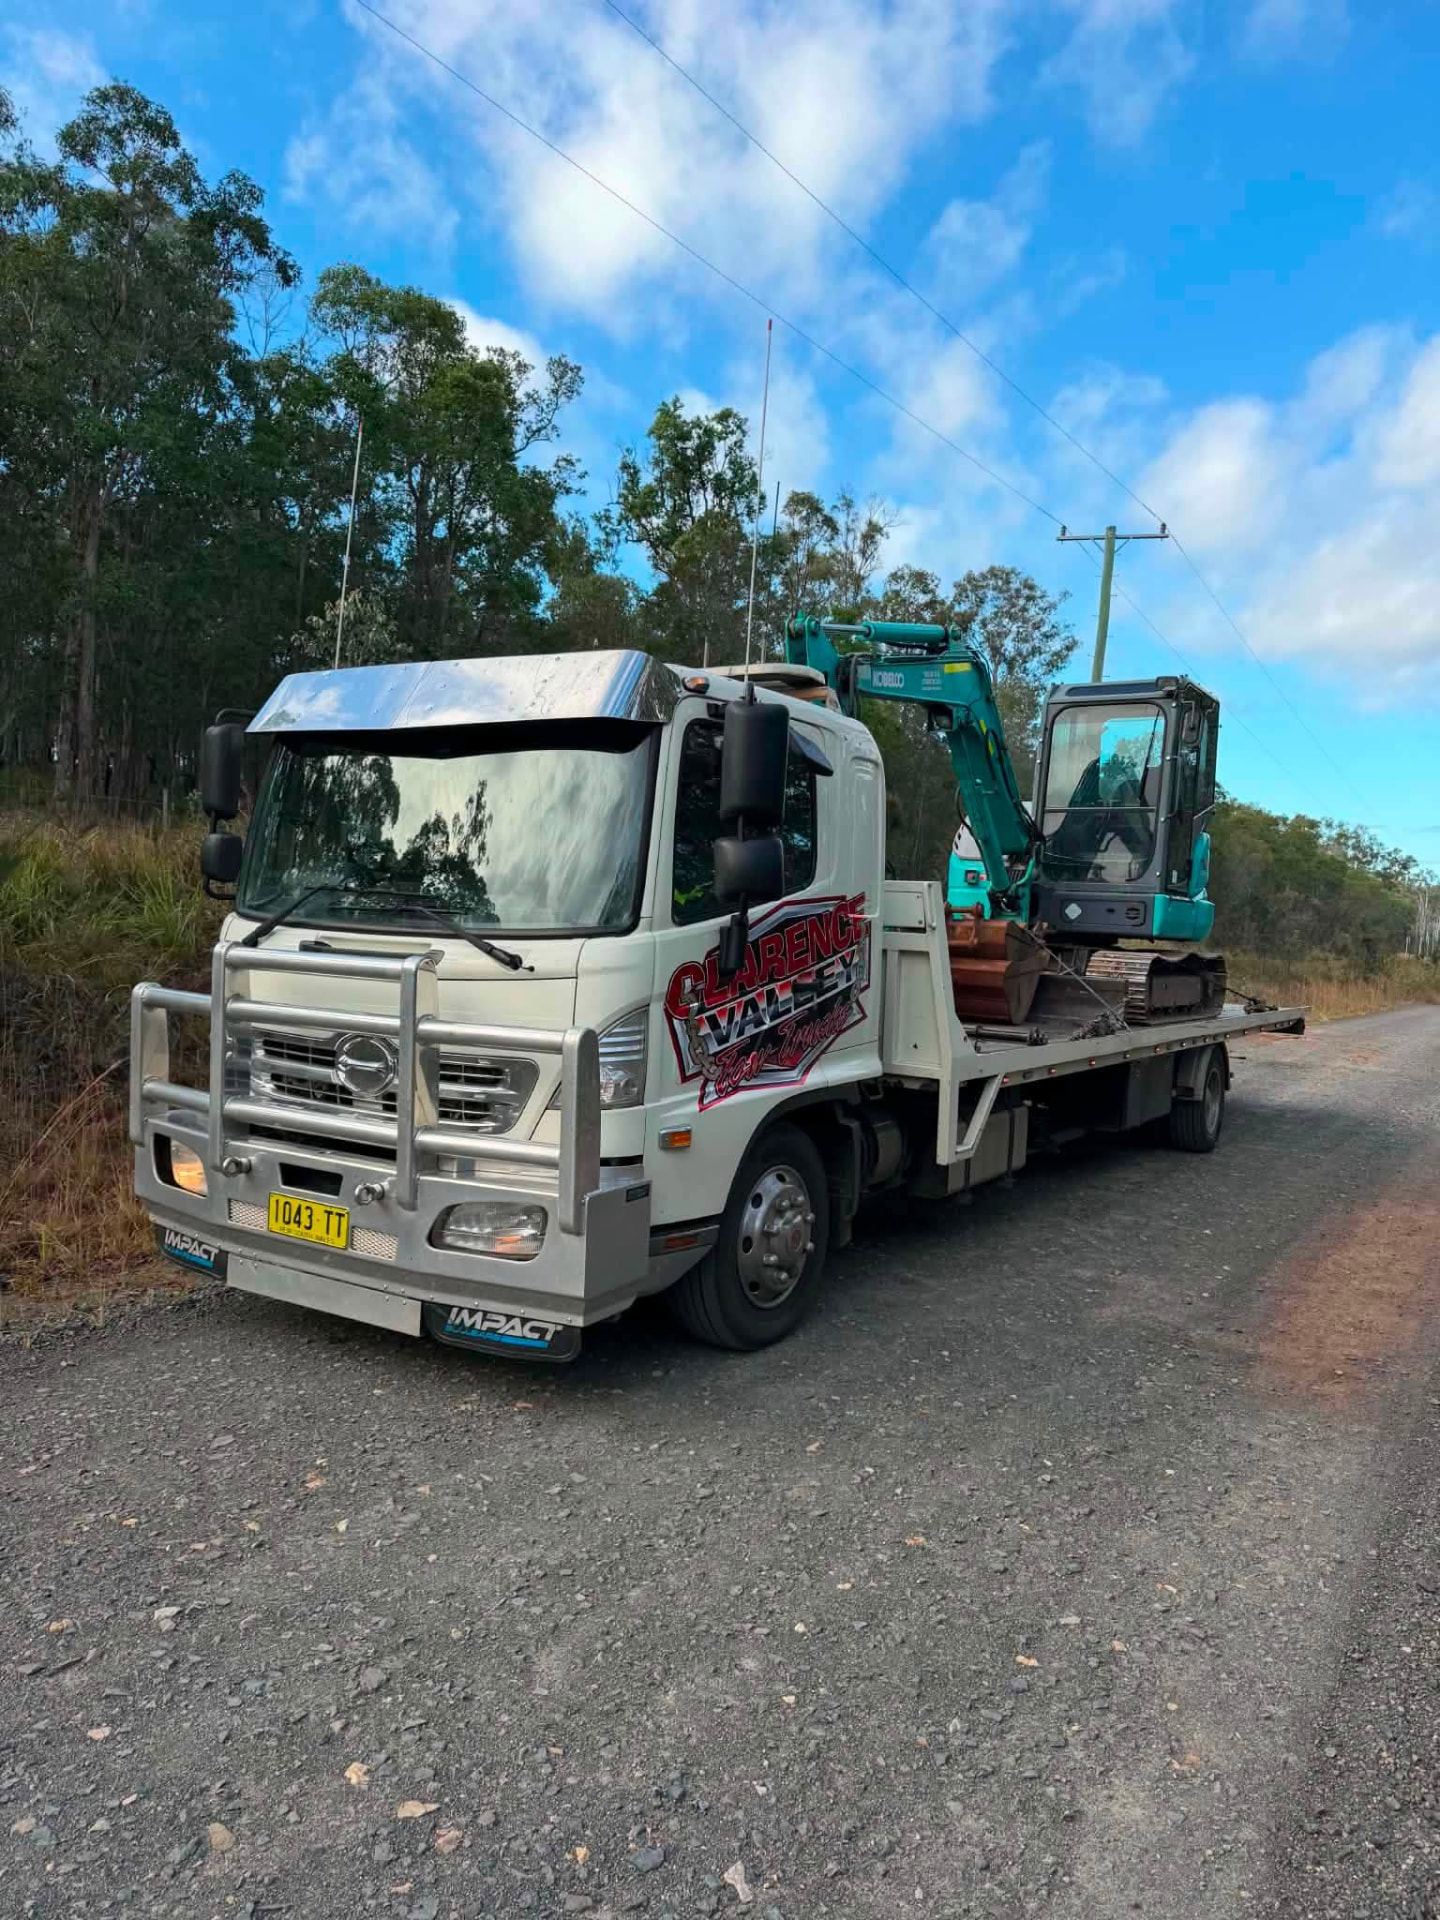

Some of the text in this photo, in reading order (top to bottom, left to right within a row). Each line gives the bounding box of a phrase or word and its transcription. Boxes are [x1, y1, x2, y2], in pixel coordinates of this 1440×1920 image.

[872, 671, 904, 688] KOBELCO
[666, 892, 867, 1020] CLARENCE
[696, 946, 859, 1054] VALLEY
[275, 1199, 345, 1238] 1043 TT
[165, 1229, 219, 1262] IMPACT
[448, 1307, 563, 1341] IMPACT
